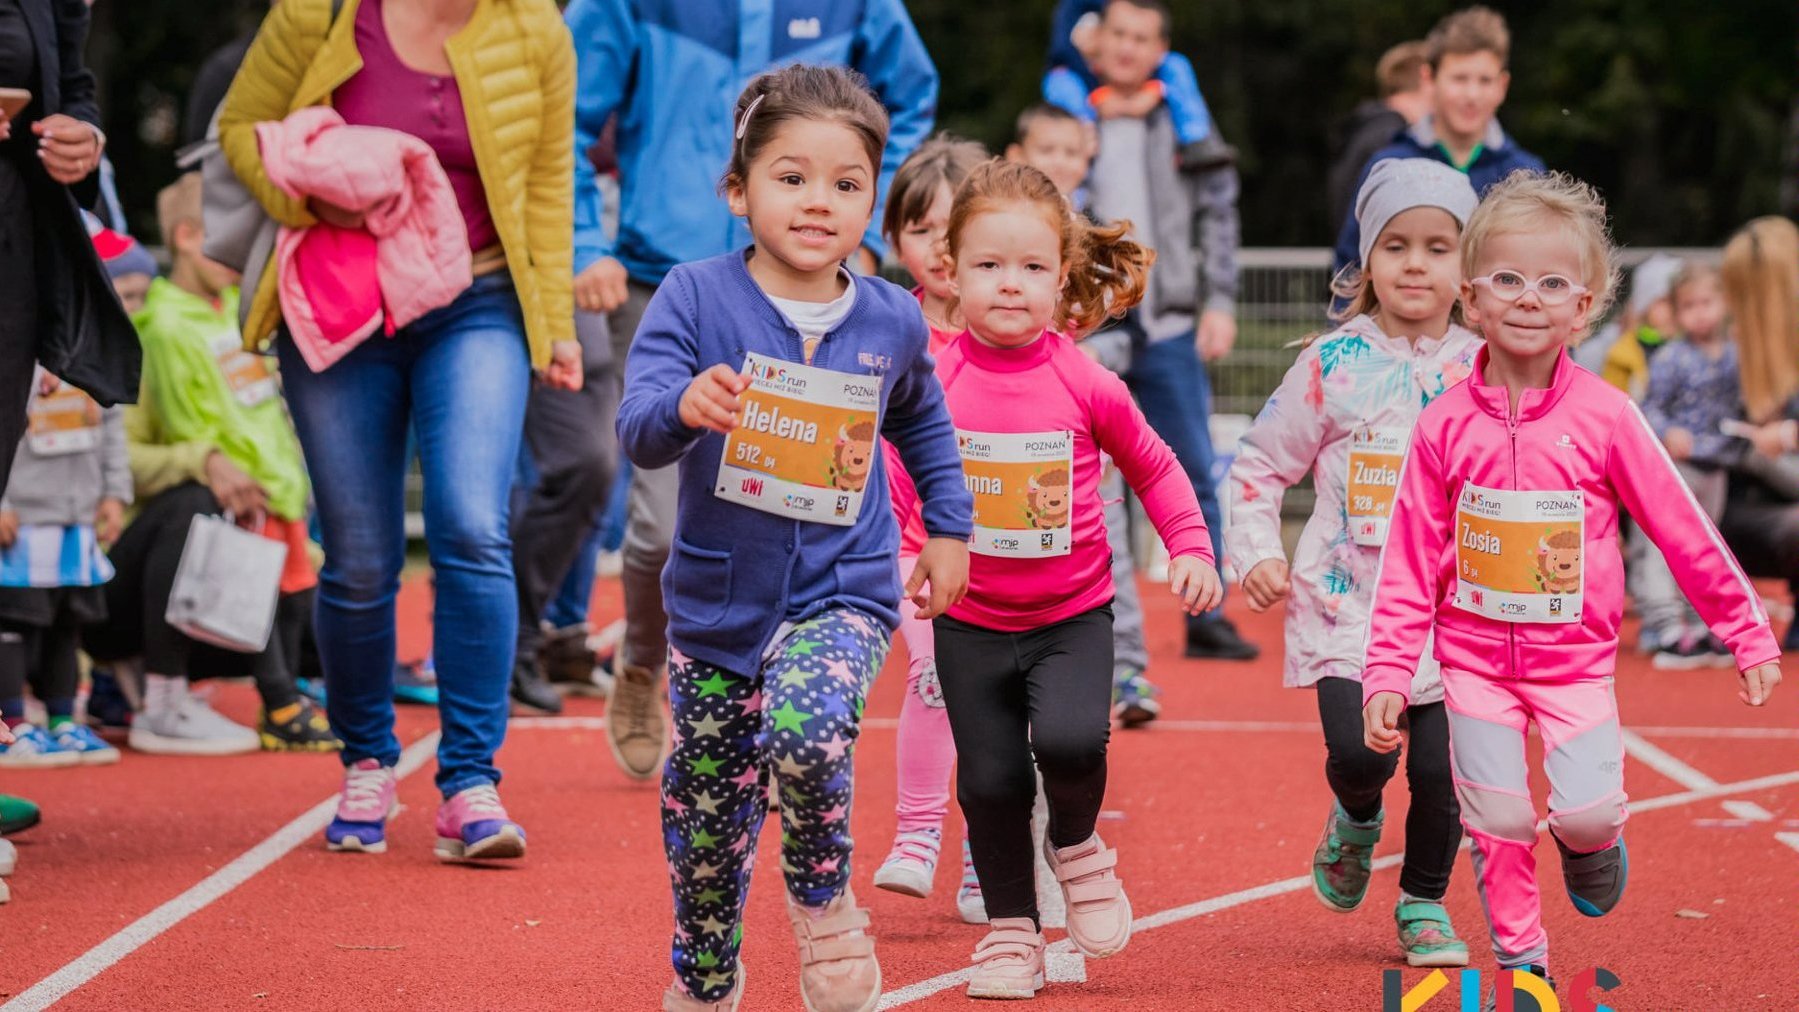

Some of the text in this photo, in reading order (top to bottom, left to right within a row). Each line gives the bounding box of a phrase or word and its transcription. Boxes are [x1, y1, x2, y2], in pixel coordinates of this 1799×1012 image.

[750, 362, 807, 388] KIDS run
[843, 384, 876, 398] POZNA
[742, 400, 818, 444] Helena
[736, 442, 761, 464] 512
[974, 443, 991, 451] run
[1354, 461, 1397, 487] Zuzia
[1485, 500, 1501, 509] run
[1462, 522, 1502, 556] Zosia
[1463, 559, 1469, 575] 6
